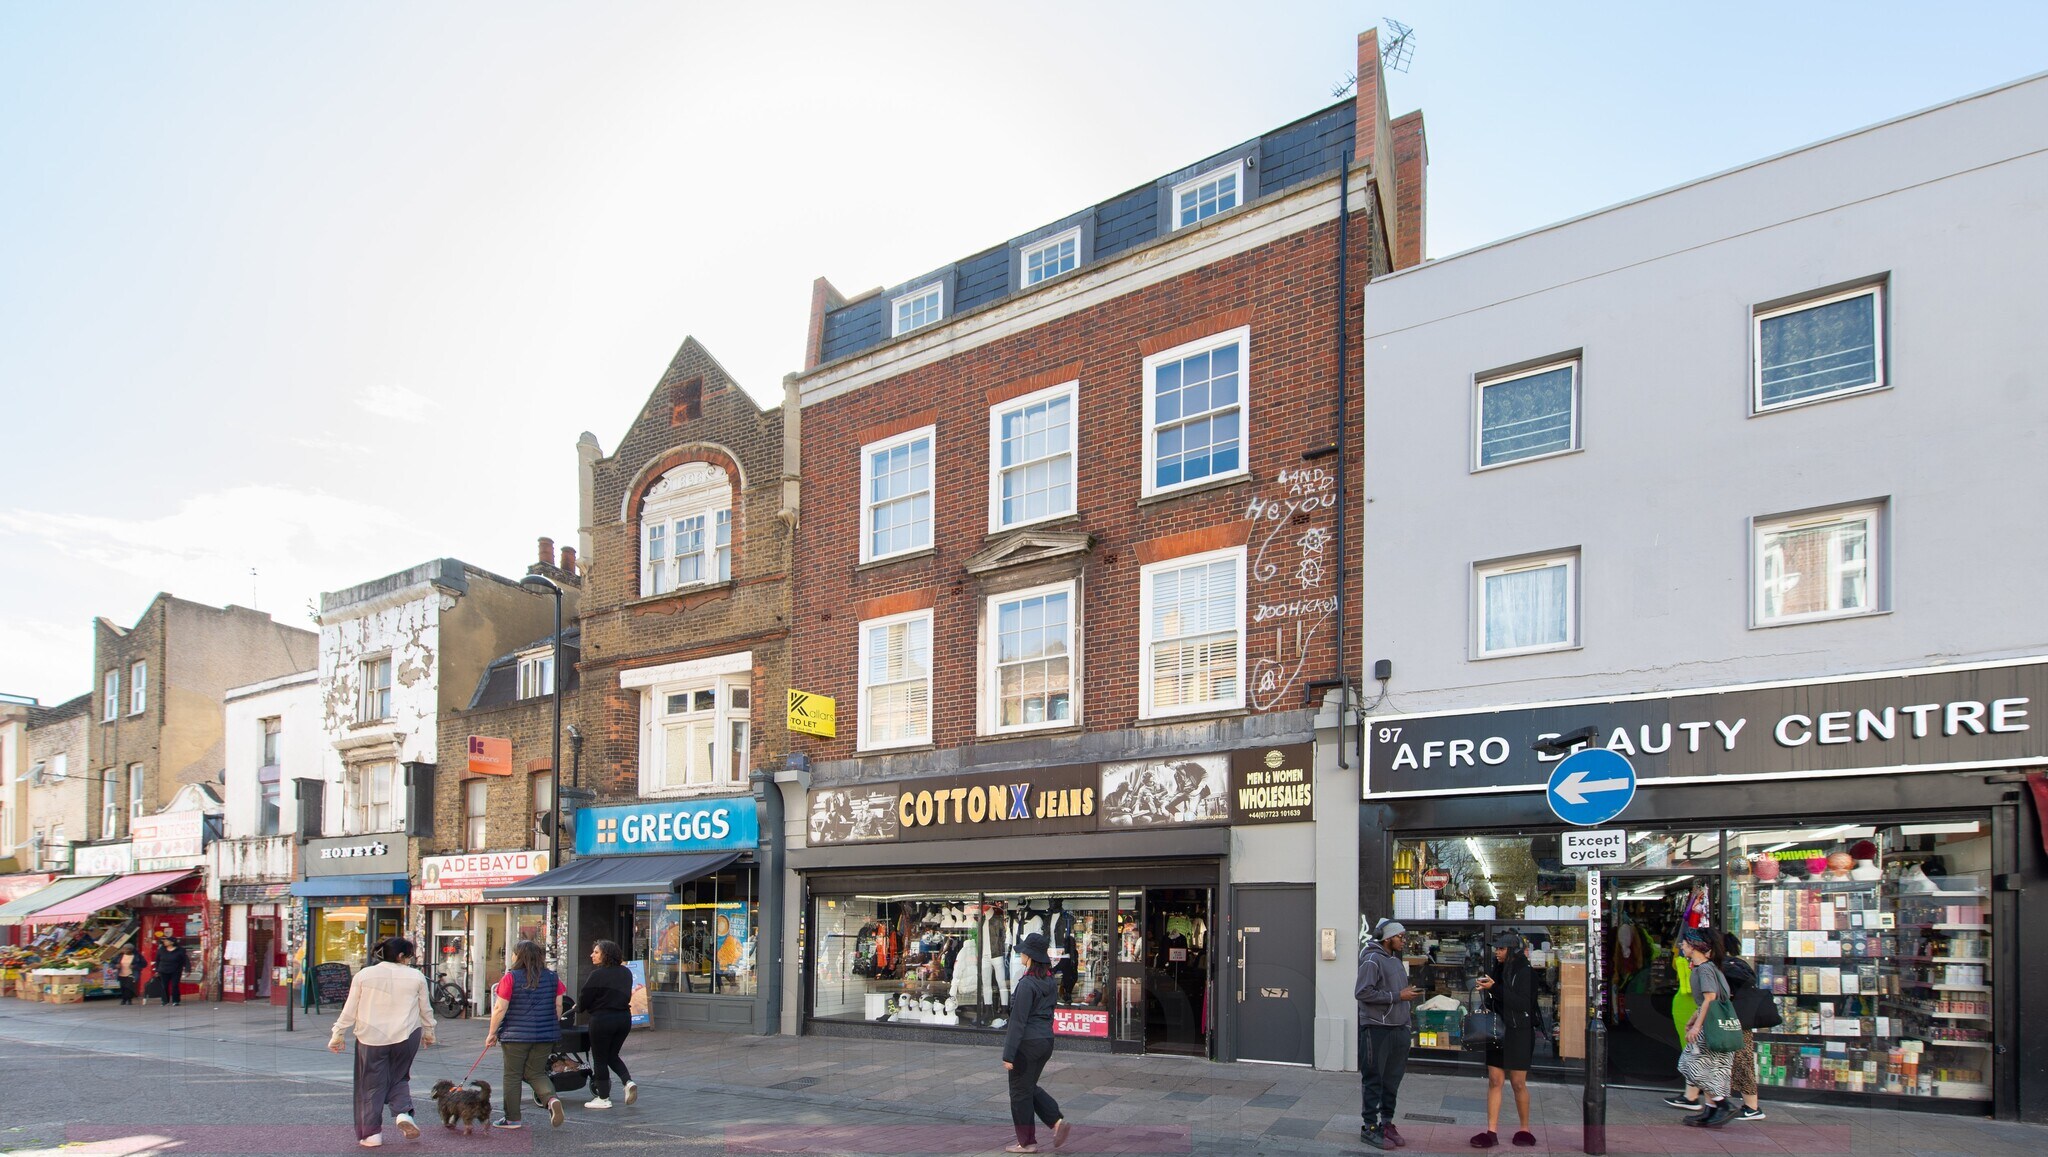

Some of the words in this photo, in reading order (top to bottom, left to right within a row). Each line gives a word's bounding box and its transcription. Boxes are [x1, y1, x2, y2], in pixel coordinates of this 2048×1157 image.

[791, 718, 801, 726] TO
[803, 720, 818, 728] LET
[1378, 727, 1403, 744] 97
[1391, 736, 1511, 771] AFRO
[1773, 697, 2031, 748] CENTRE
[1246, 772, 1264, 786] MEN
[1264, 771, 1271, 784] &
[1272, 769, 1304, 784] WOMEN
[1035, 787, 1094, 819] JEANS
[1239, 784, 1312, 810] WHOLESALES
[622, 808, 730, 843] GREGGS
[1568, 835, 1620, 847] Except
[320, 841, 387, 859] HONEY'S
[1570, 849, 1617, 861] cycles
[441, 855, 528, 873] ADEBAYO
[1074, 1013, 1107, 1024] PRICE
[1058, 1022, 1091, 1033] SALE
